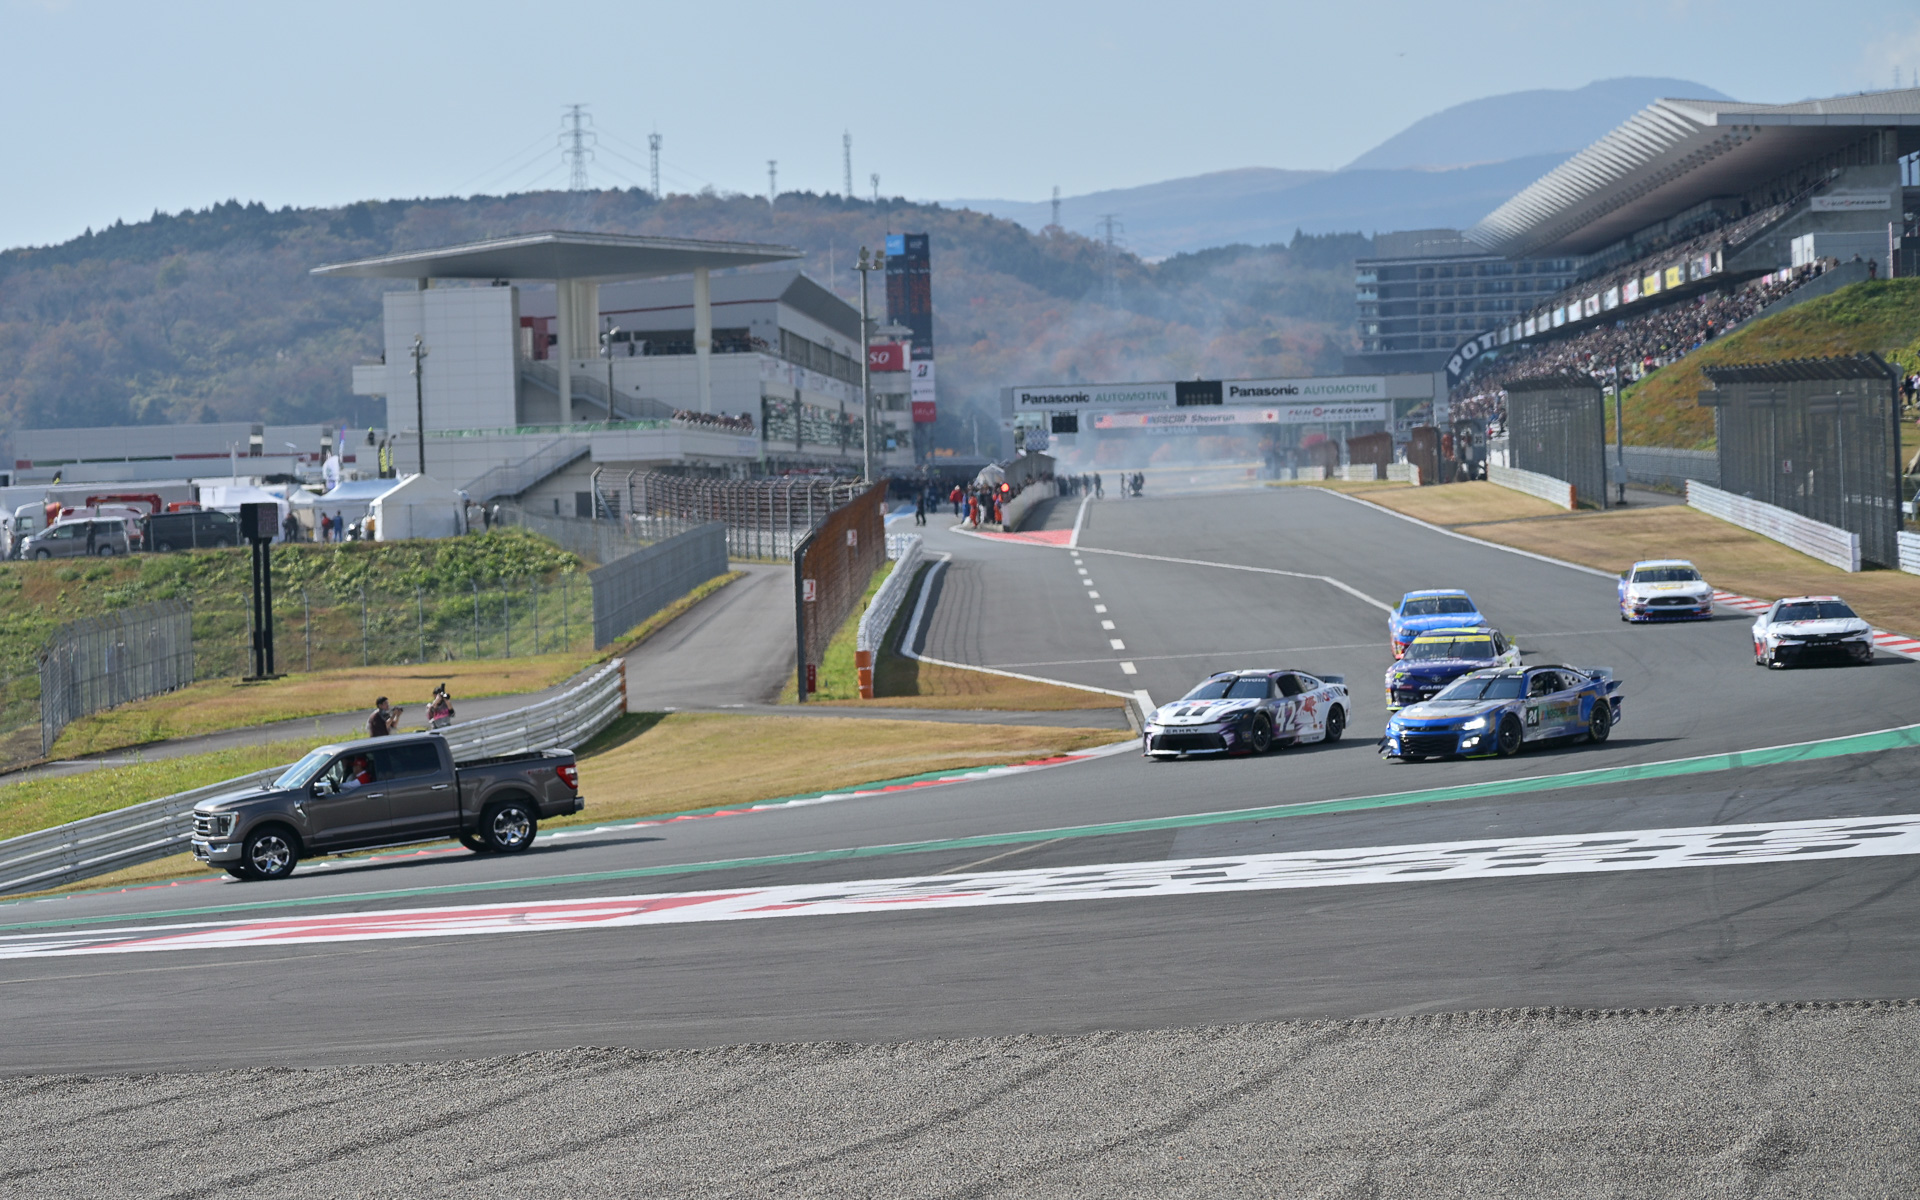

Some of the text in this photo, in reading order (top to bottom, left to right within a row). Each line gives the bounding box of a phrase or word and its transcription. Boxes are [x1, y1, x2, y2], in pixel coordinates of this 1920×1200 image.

[1021, 390, 1168, 405] Panasonic AUTOMOTIVE
[1229, 383, 1378, 397] Panasonic AUTOMOTIVE
[1275, 700, 1297, 733] 42
[1527, 706, 1539, 724] 24
